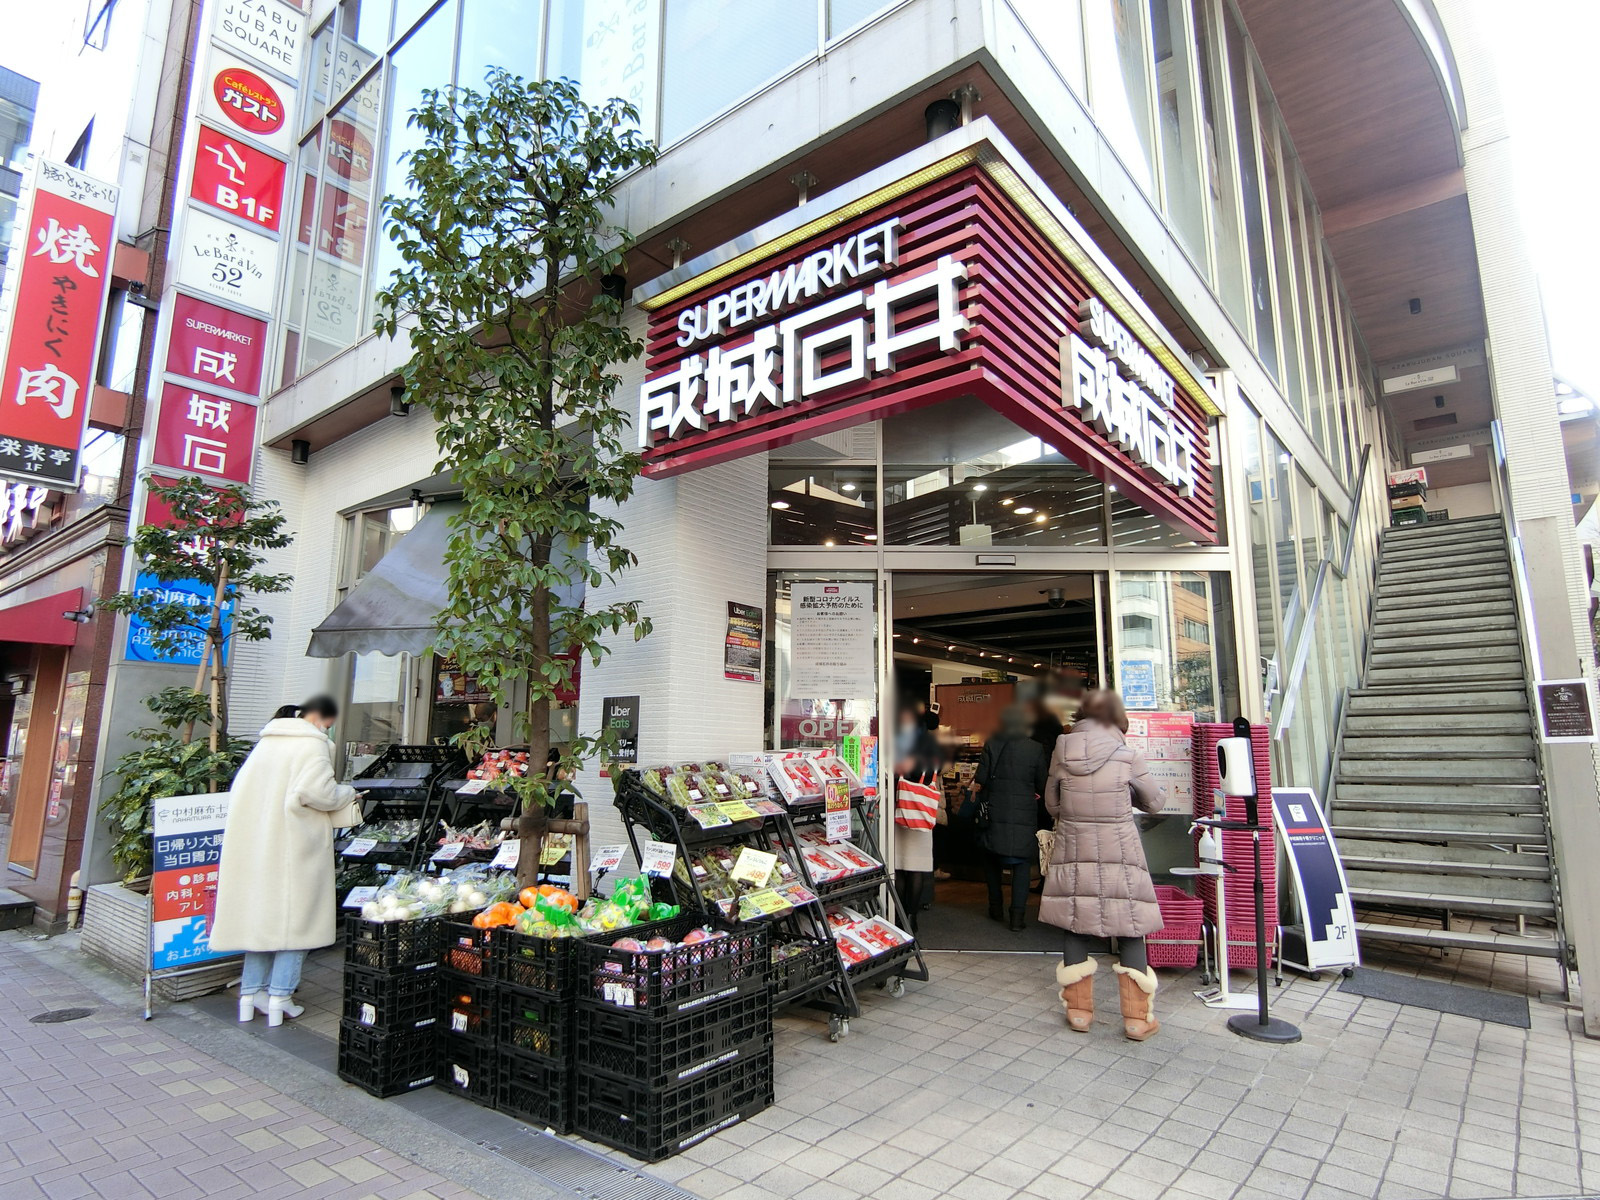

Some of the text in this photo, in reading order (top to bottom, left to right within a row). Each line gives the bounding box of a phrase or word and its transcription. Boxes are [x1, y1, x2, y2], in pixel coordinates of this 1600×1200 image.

[222, 19, 293, 66] SQUARE
[225, 5, 295, 49] JUBAN
[222, 88, 279, 122] ガスト
[69, 190, 86, 200] 2F
[215, 184, 275, 223] B1F
[31, 217, 101, 278] 焼
[193, 245, 211, 257] Le
[213, 247, 236, 263] Bar
[246, 259, 263, 280] Vin
[211, 262, 243, 289] 52
[677, 216, 905, 348] SUPERMARKET
[43, 275, 78, 358] やきにく
[185, 318, 253, 346] SUPERMARKET
[637, 253, 970, 449] 成城石井
[15, 363, 81, 420] 肉
[1060, 333, 1198, 498] 成城石井
[0, 437, 71, 467] 栄来亭
[25, 462, 43, 472] 1F
[733, 606, 746, 616] Uber
[610, 705, 631, 717] Uber
[610, 717, 630, 729] Eats
[1335, 925, 1348, 940] 2F
